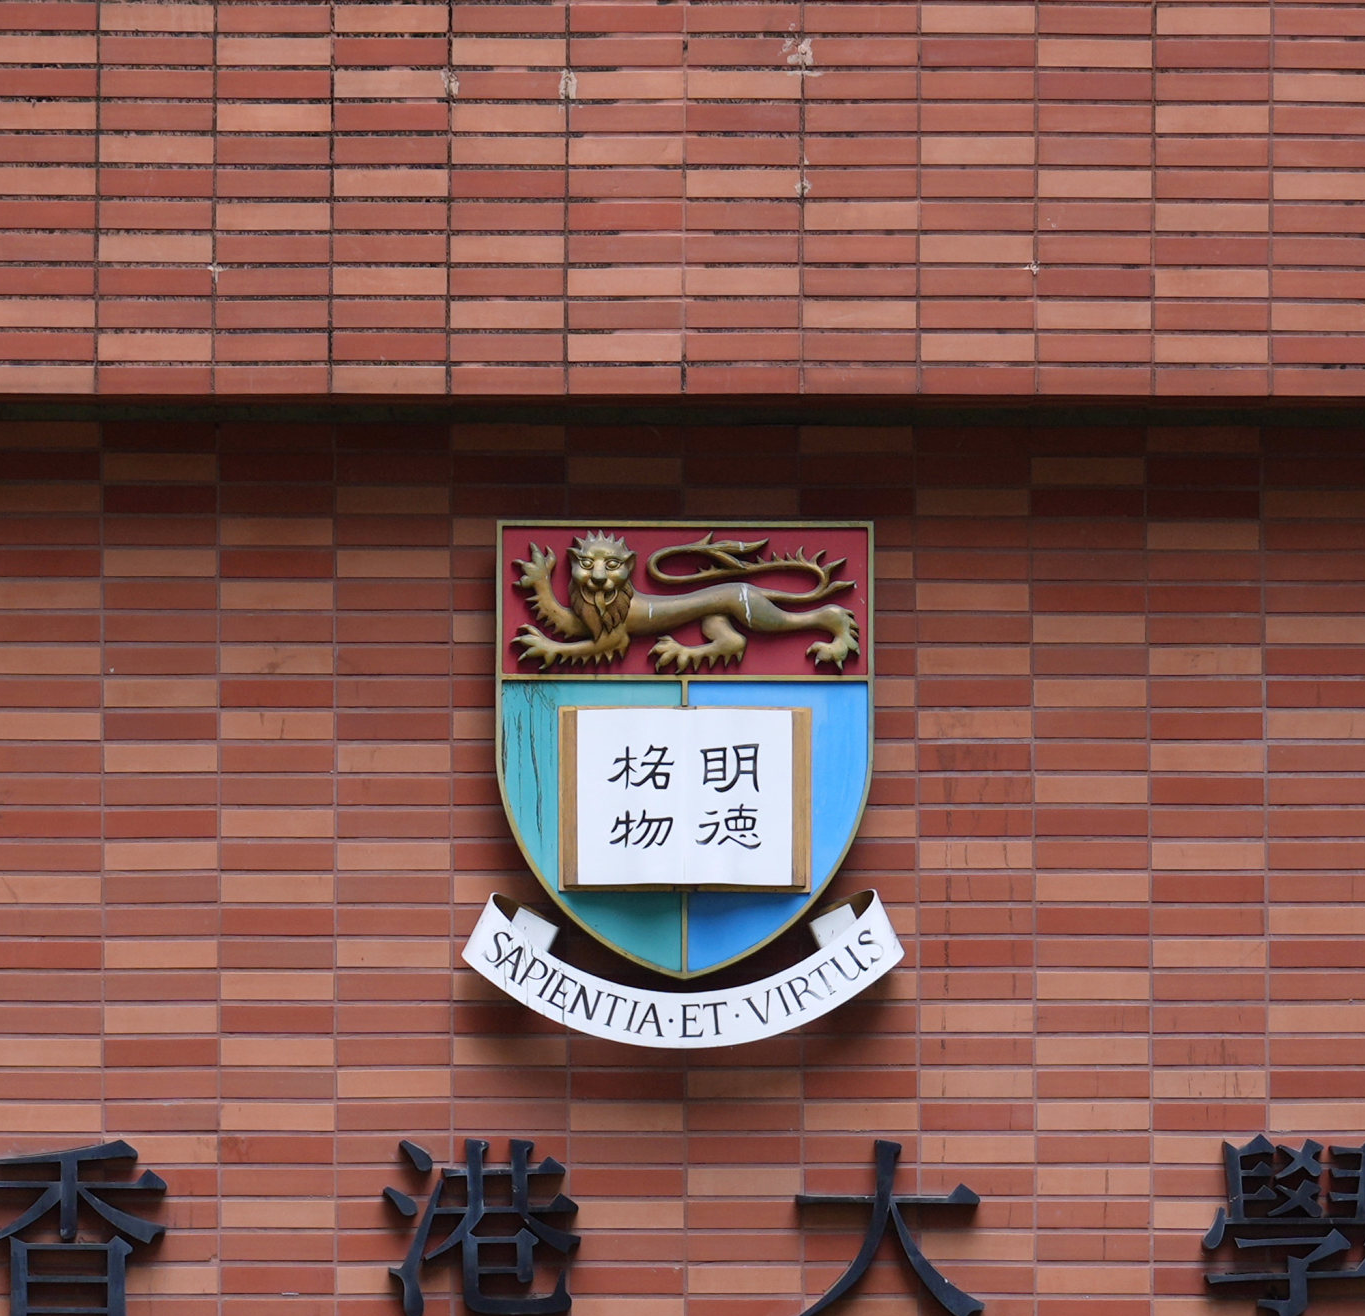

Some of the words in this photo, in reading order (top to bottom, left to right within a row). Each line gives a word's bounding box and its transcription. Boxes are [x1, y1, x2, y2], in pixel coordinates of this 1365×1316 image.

[483, 930, 664, 1038] SAPIENTIA
[679, 1001, 728, 1039] ET
[743, 927, 886, 1026] VIRTUS
